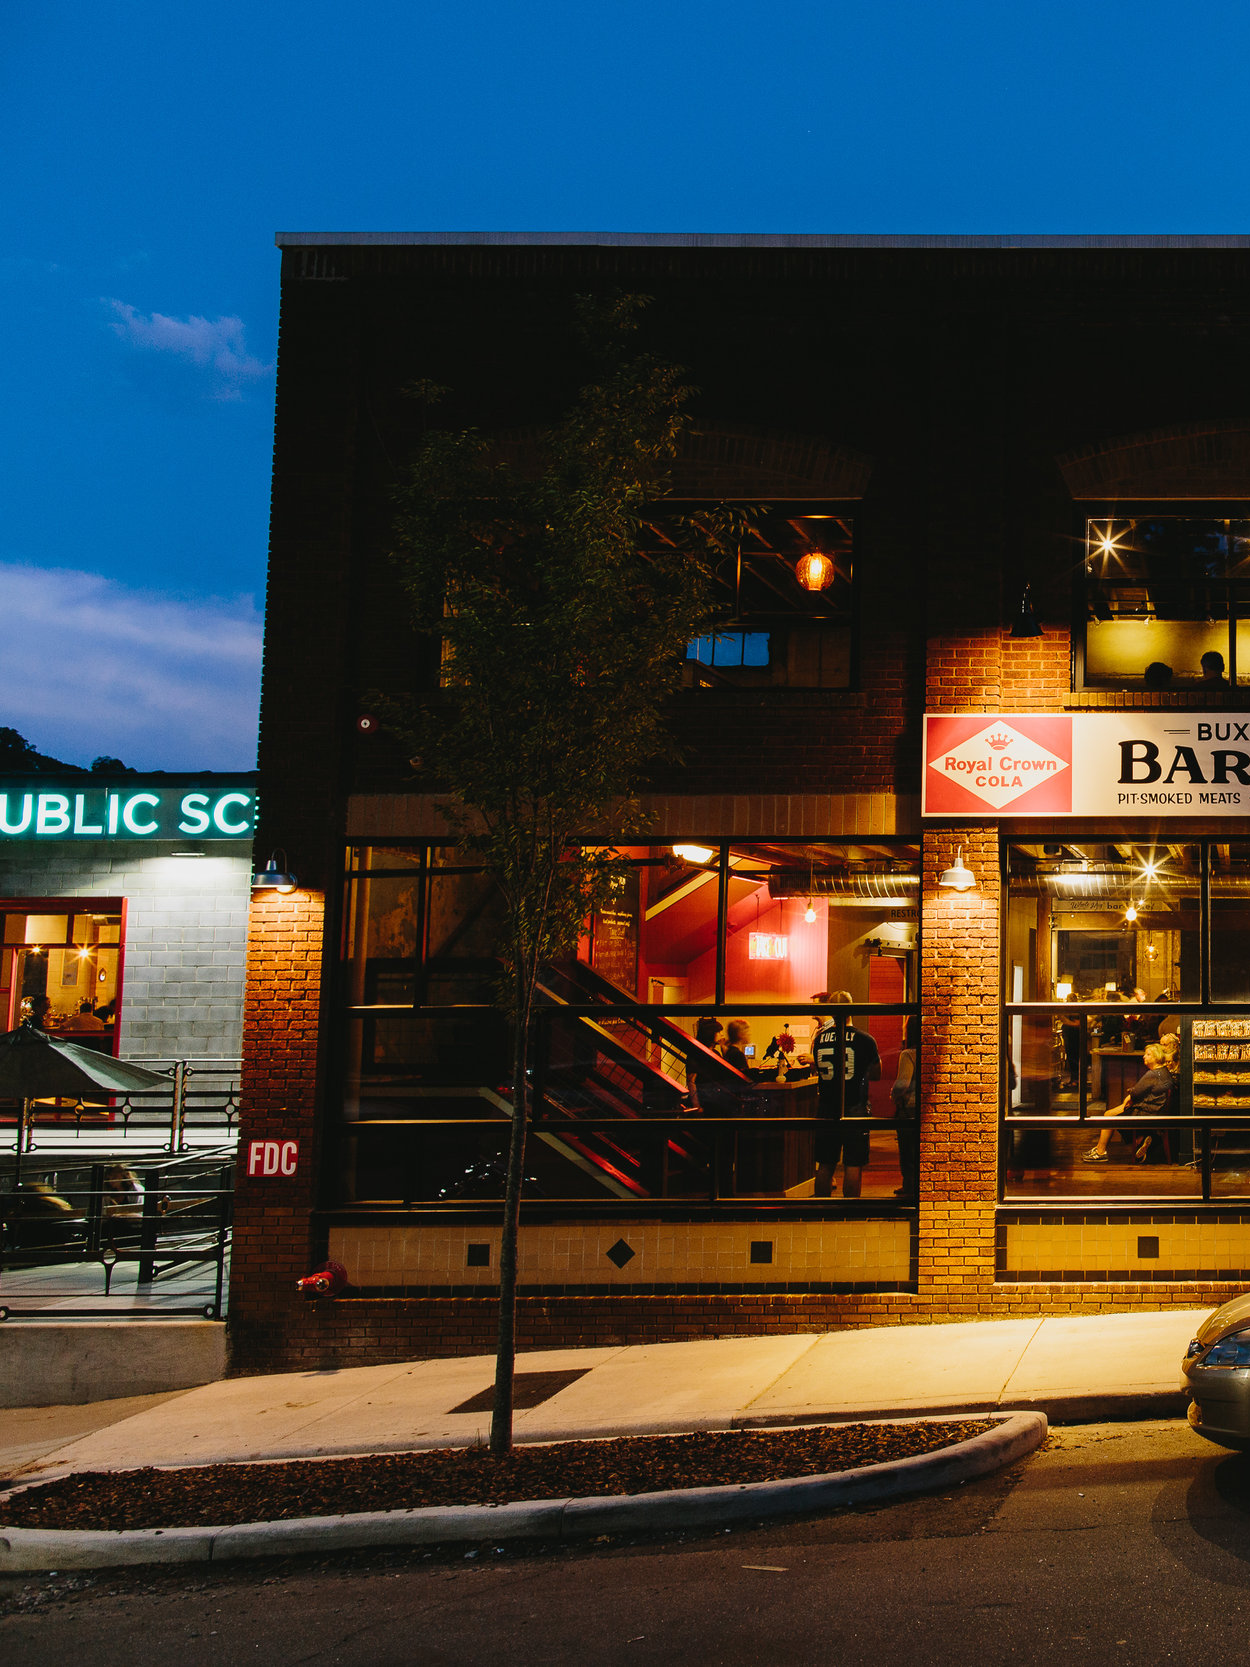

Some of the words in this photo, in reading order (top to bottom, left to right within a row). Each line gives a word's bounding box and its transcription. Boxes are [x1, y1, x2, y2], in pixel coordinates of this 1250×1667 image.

[945, 757, 992, 774] Royal
[1000, 756, 1057, 771] Crown
[975, 775, 1023, 787] COLA
[1199, 792, 1241, 804] MEATS
[0, 793, 160, 835] UBLIC
[820, 1031, 856, 1044] KUELY
[249, 1142, 297, 1175] FDC
